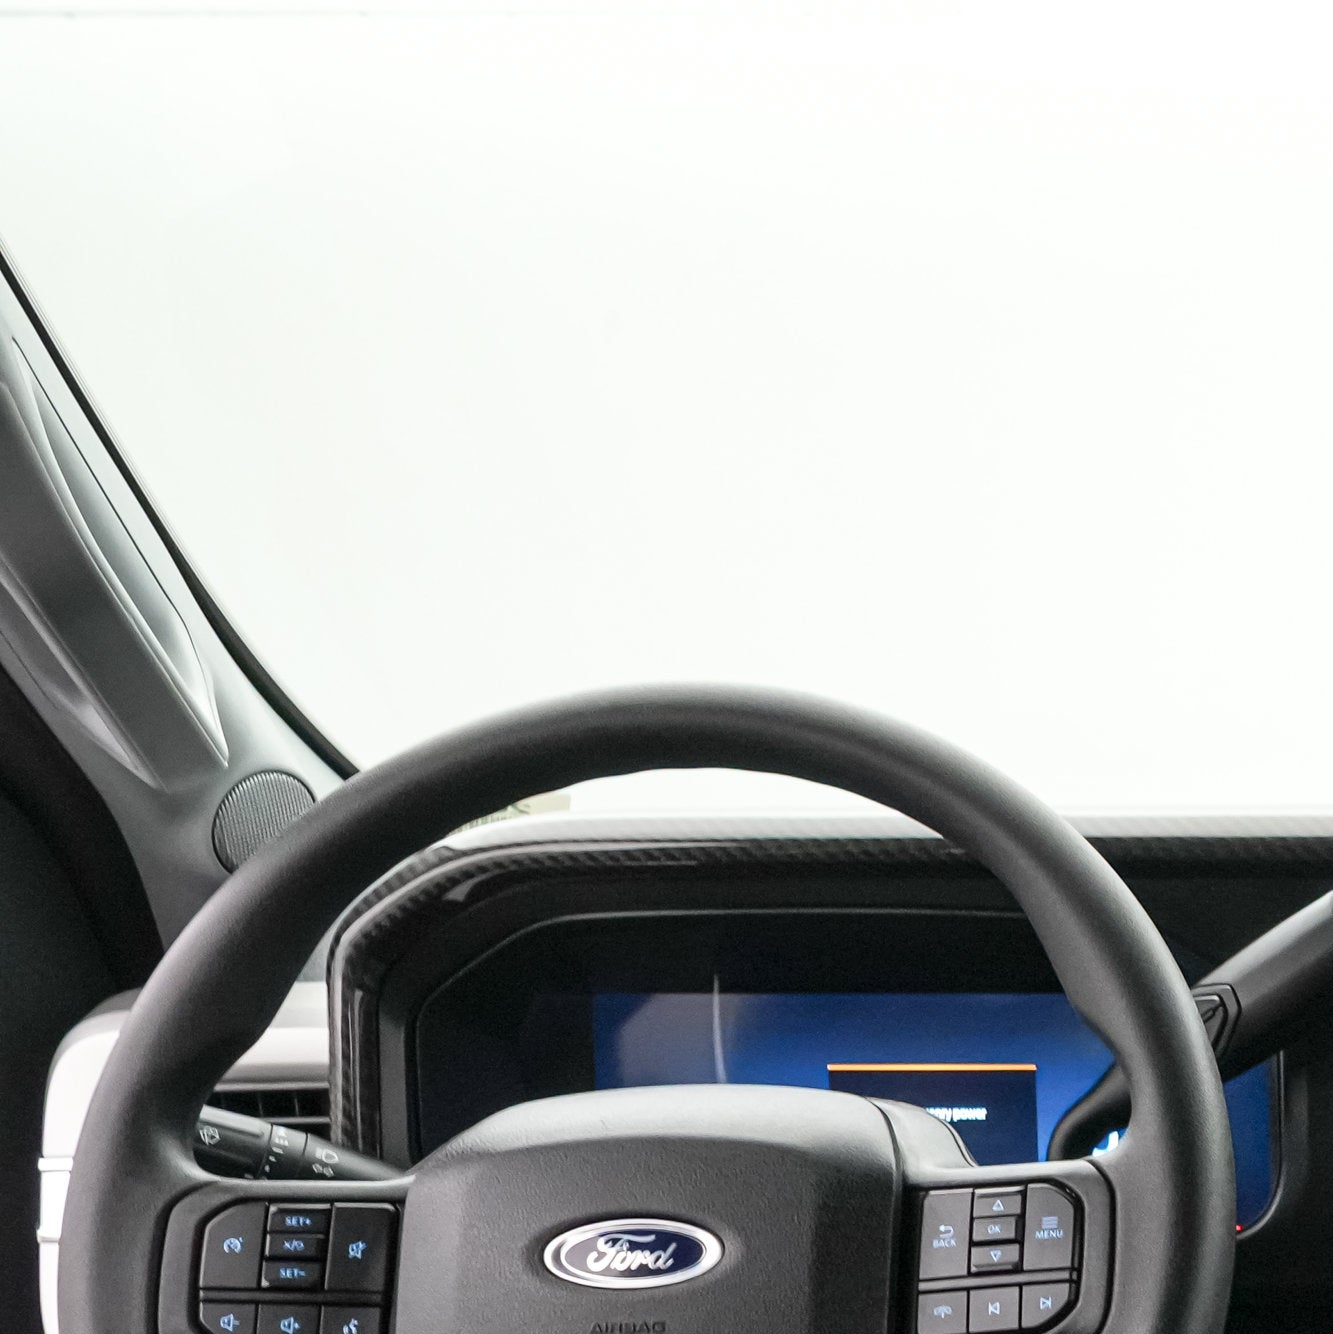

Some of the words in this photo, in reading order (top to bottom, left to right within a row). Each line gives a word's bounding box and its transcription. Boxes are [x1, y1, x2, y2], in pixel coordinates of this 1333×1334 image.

[987, 1224, 1001, 1234] OK
[1035, 1229, 1064, 1240] MENU
[932, 1239, 957, 1249] BACK
[587, 1233, 677, 1272] Ford
